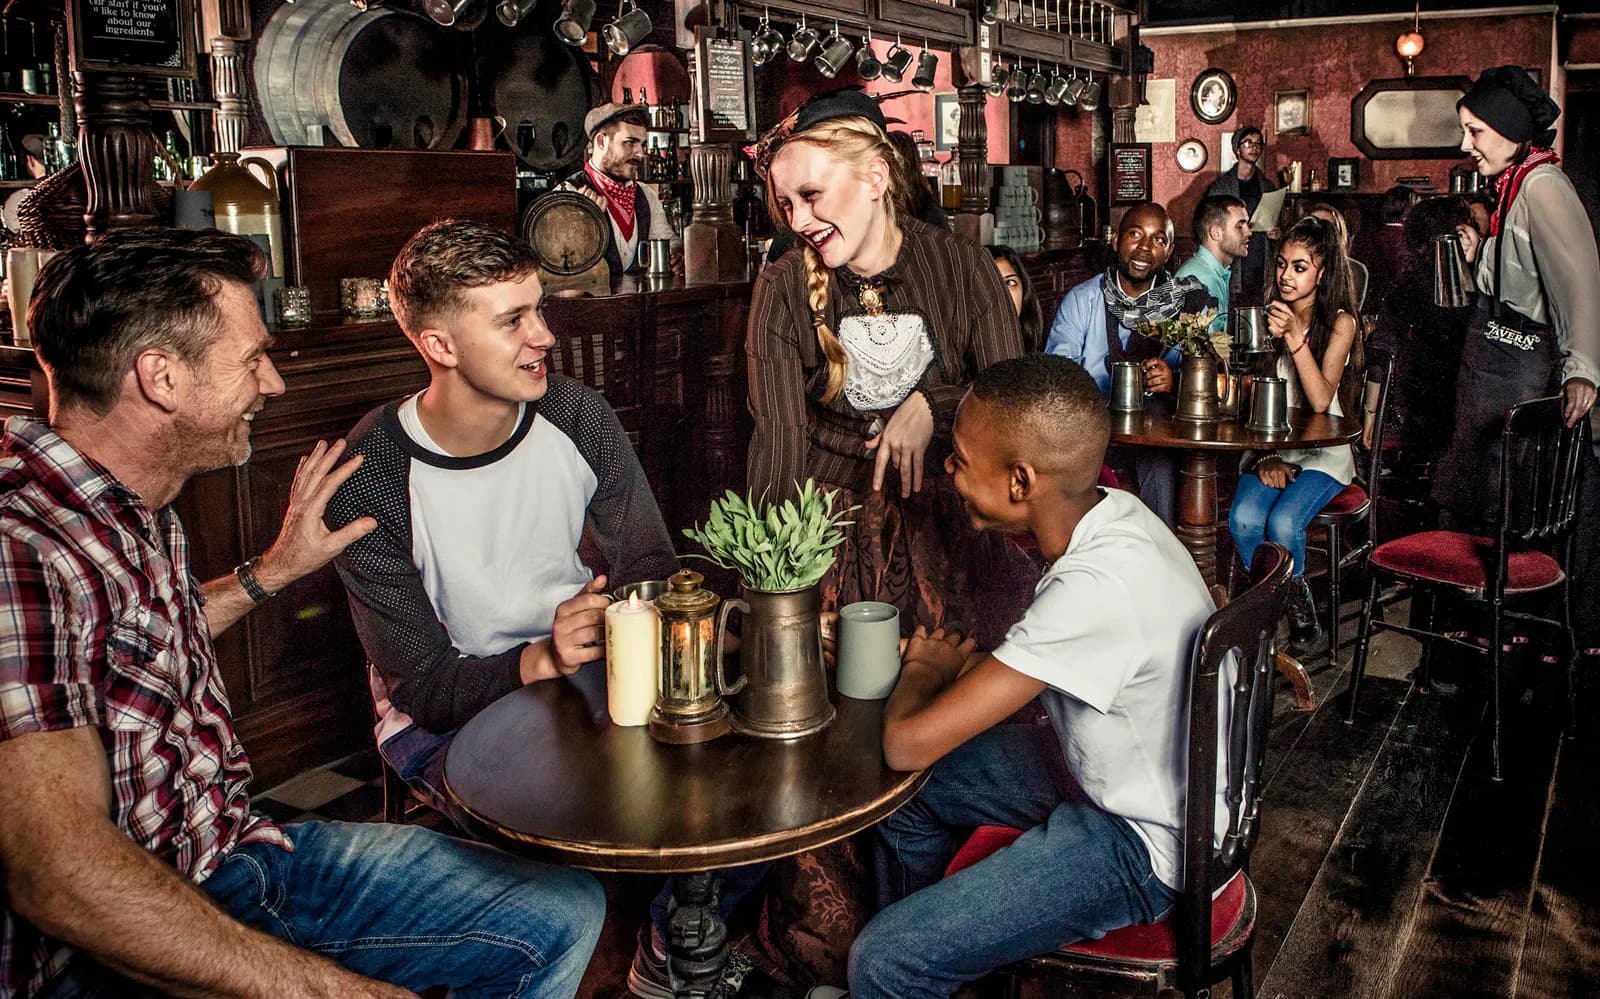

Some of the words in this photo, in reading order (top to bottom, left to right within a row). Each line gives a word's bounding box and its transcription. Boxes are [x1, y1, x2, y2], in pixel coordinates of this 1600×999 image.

[132, 1, 139, 9] if
[101, 6, 118, 16] like
[120, 9, 130, 17] to
[133, 9, 156, 19] know
[107, 17, 133, 26] about
[136, 20, 151, 28] our
[105, 25, 154, 36] ingredients
[1488, 325, 1535, 346] TAVERN
